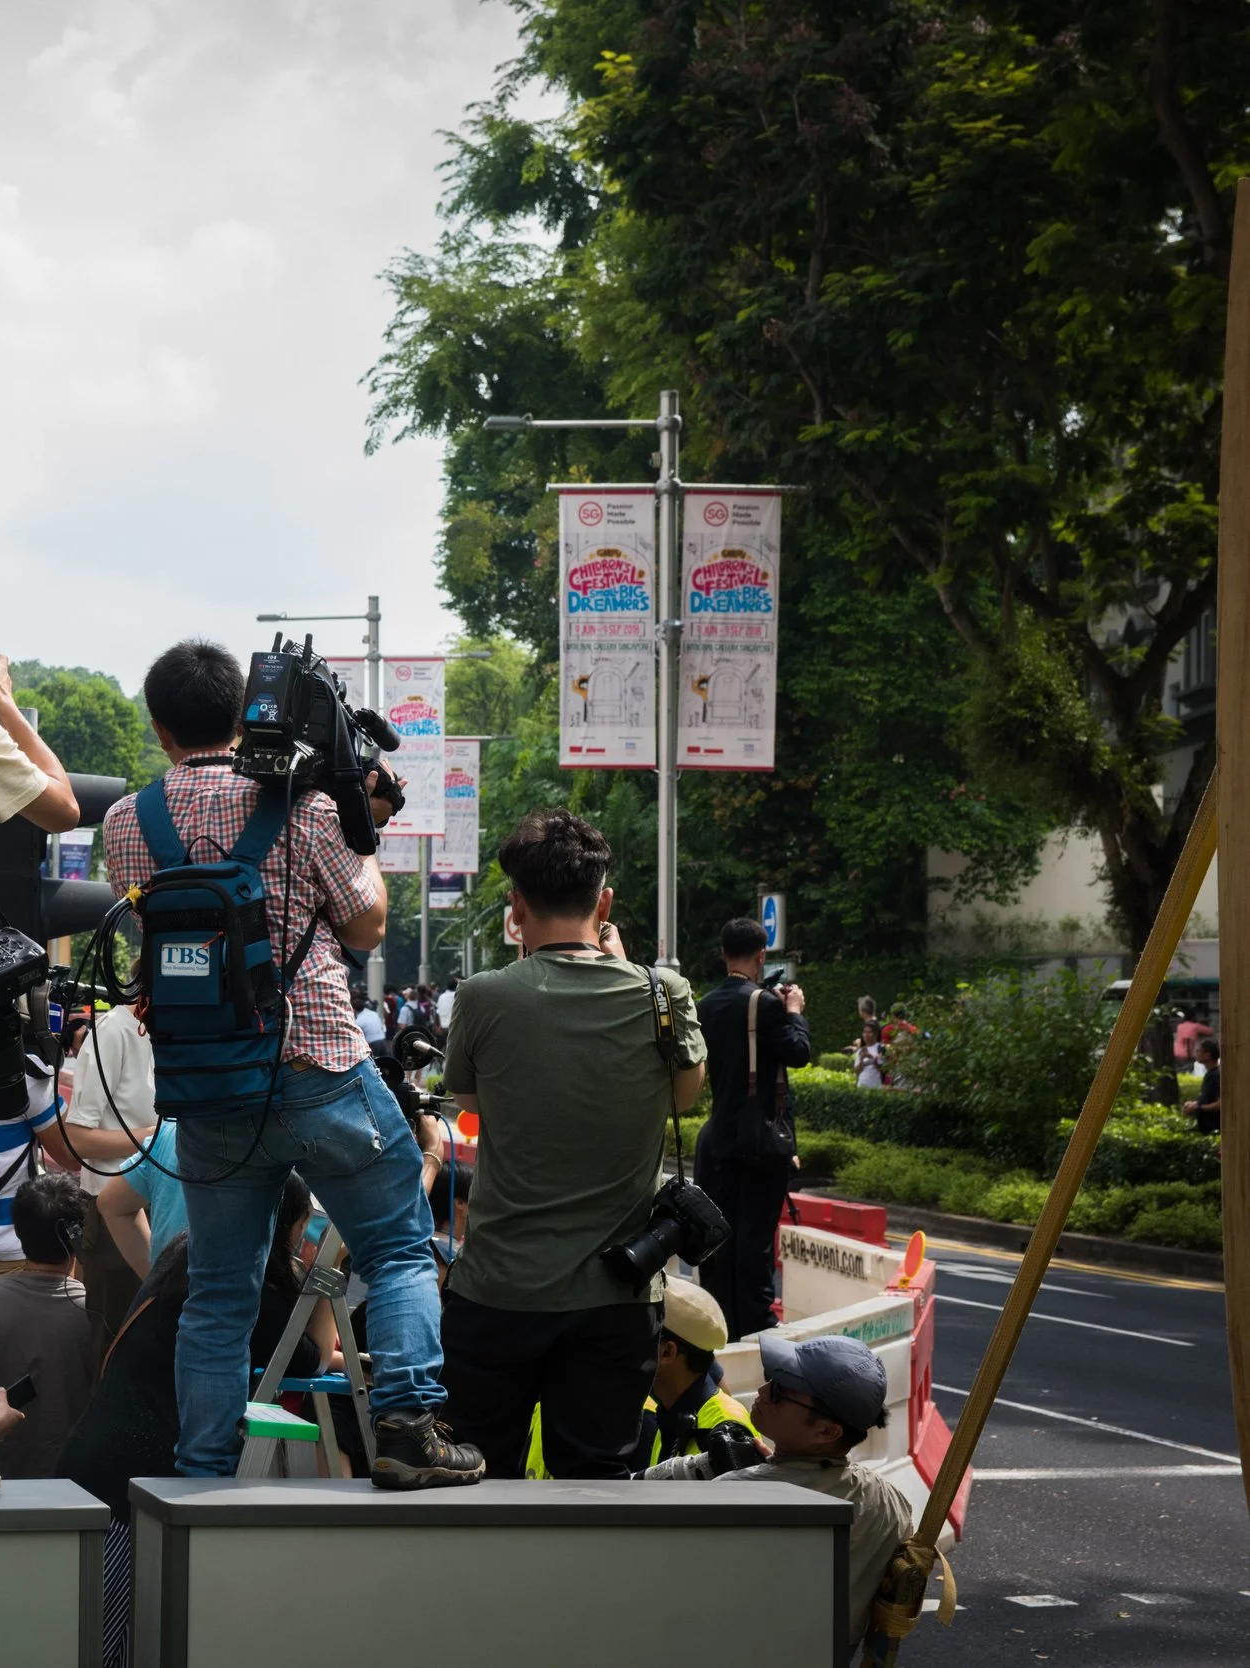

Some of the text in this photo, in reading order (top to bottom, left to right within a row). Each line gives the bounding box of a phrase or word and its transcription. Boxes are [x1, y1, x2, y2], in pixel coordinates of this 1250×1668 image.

[582, 508, 600, 519] SG
[619, 585, 646, 598] BIG
[742, 586, 769, 599] BIG
[162, 946, 209, 965] TBS
[655, 983, 669, 1013] NPS
